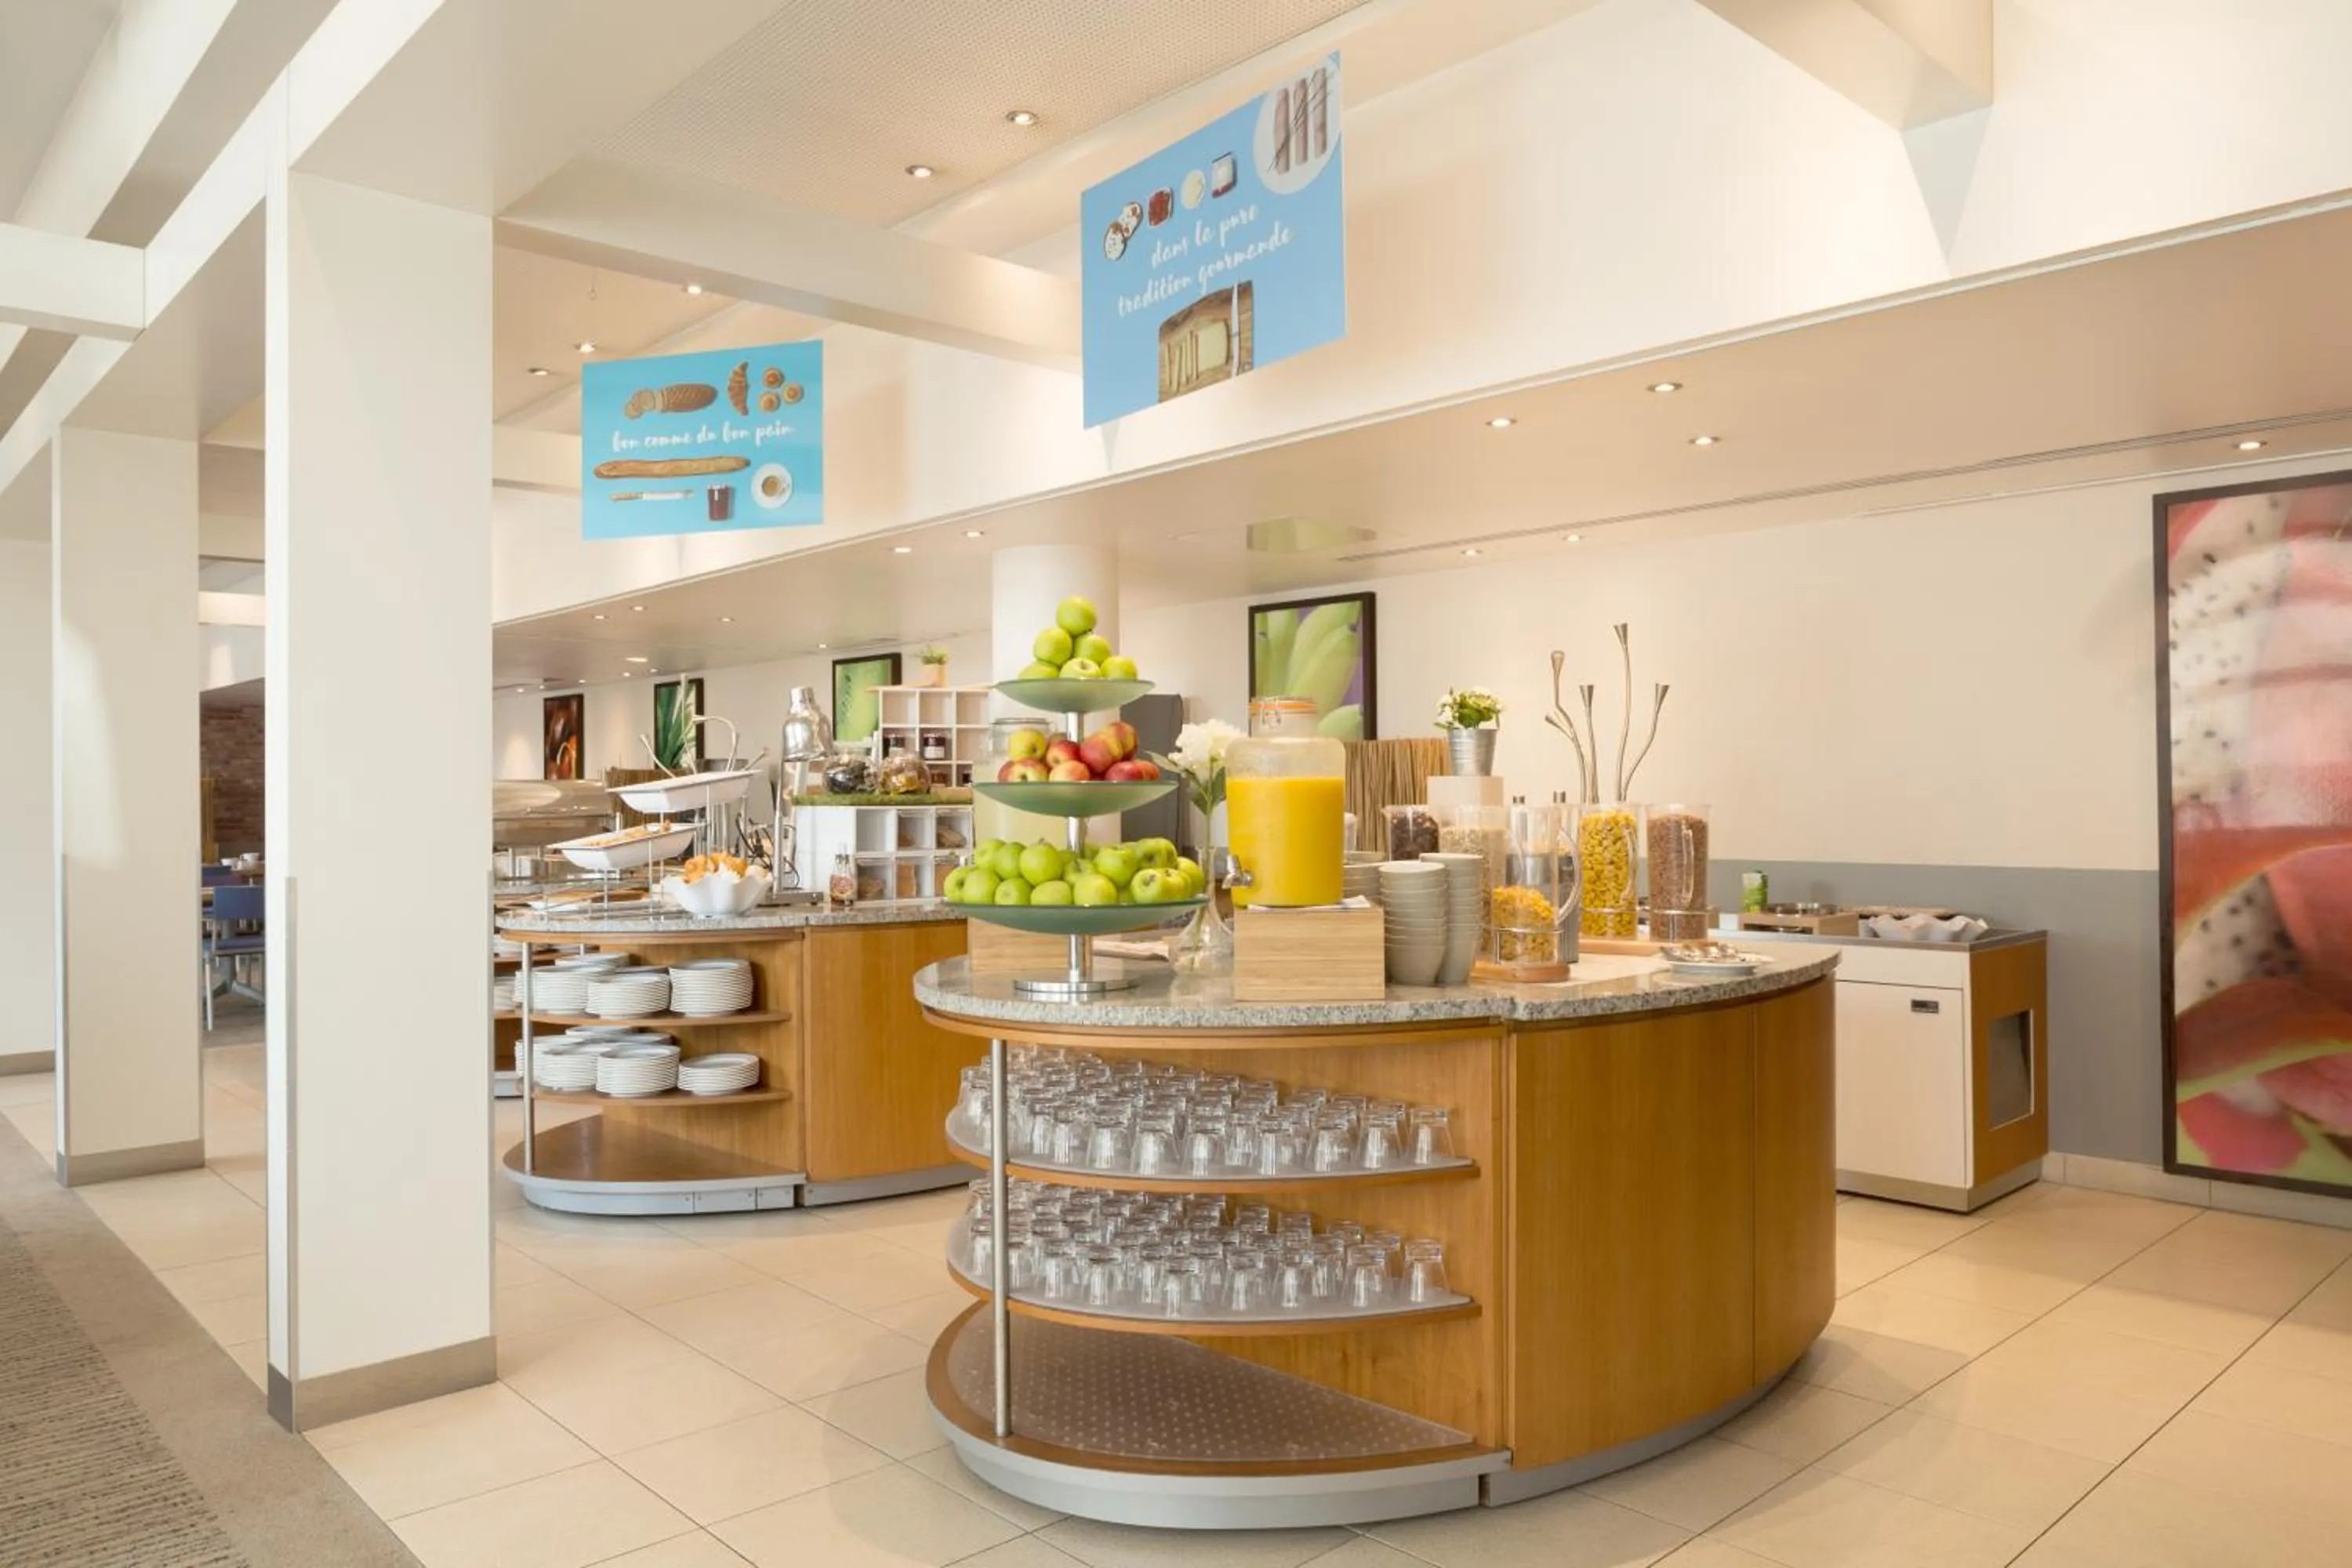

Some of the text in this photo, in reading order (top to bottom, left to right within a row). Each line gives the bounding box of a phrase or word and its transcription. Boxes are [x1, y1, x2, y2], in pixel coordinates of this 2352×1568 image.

[1118, 220, 1293, 317] tradition gourmande
[1151, 205, 1259, 269] dans la pure
[612, 419, 796, 452] bon comme du bon pain
